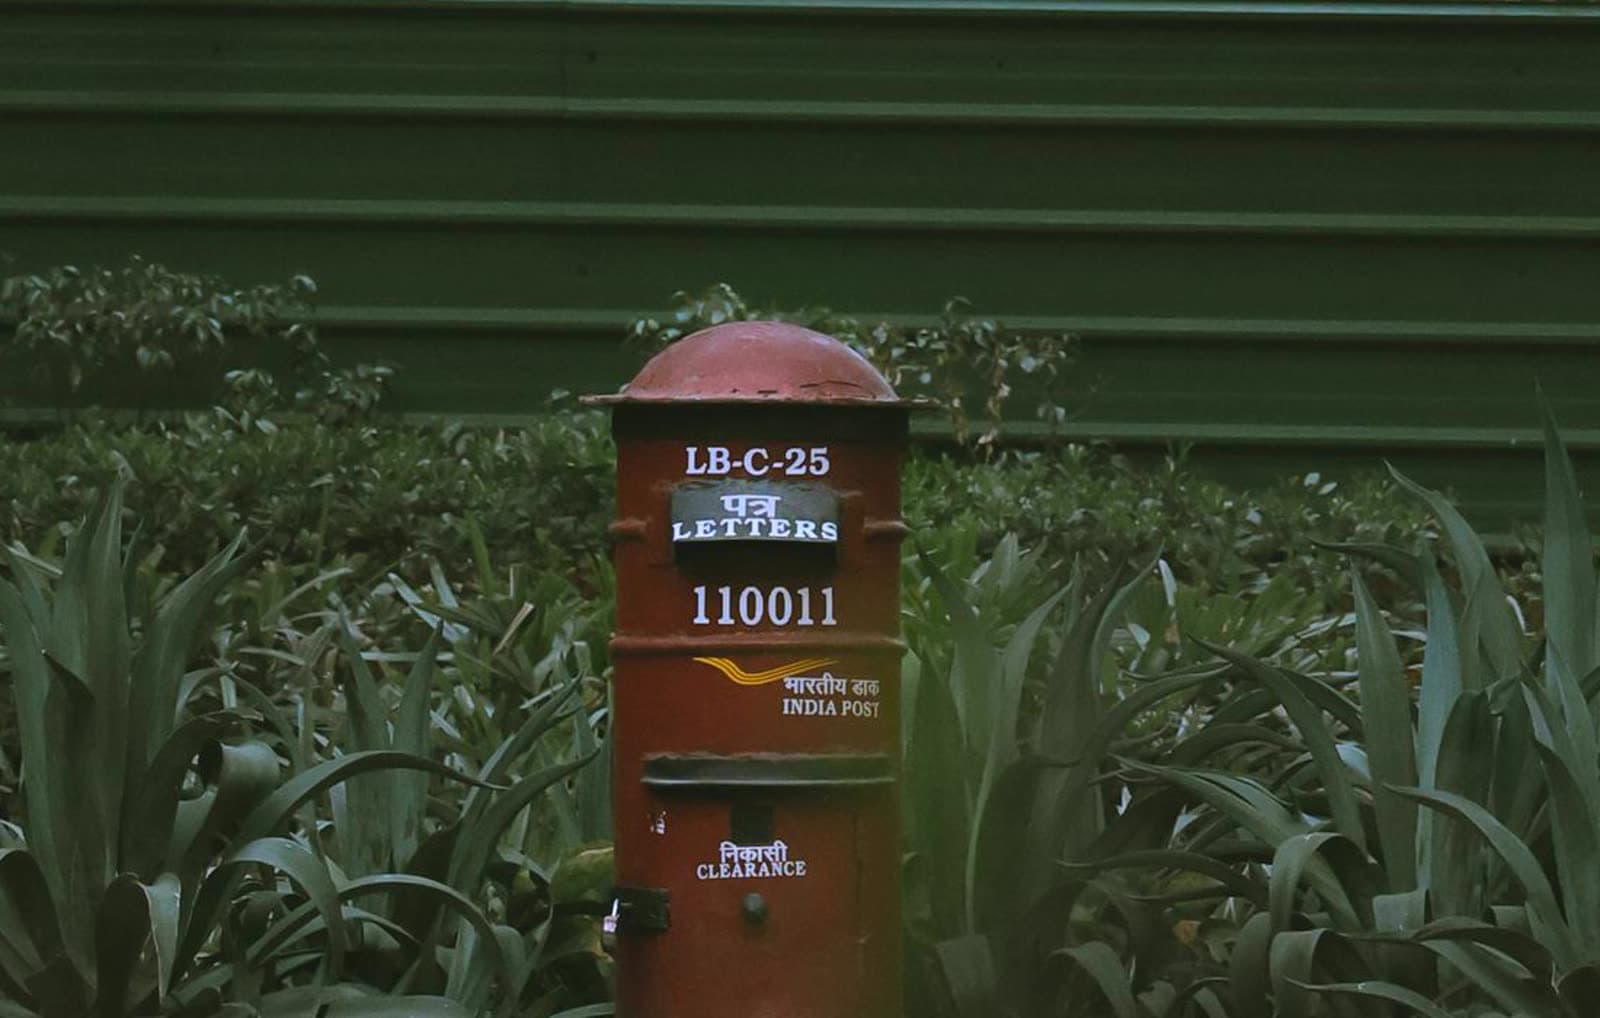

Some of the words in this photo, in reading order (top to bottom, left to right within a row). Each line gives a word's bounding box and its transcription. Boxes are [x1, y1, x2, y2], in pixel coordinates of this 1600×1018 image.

[686, 446, 830, 476] LB-C-25
[720, 493, 781, 518] पत्र
[672, 519, 838, 542] LETTERS
[693, 586, 837, 626] 110011
[783, 672, 847, 696] भारतीय
[783, 698, 837, 716] INDIA
[841, 700, 880, 718] POST
[719, 840, 788, 864] निकासी
[697, 860, 807, 880] CLEARANCE
